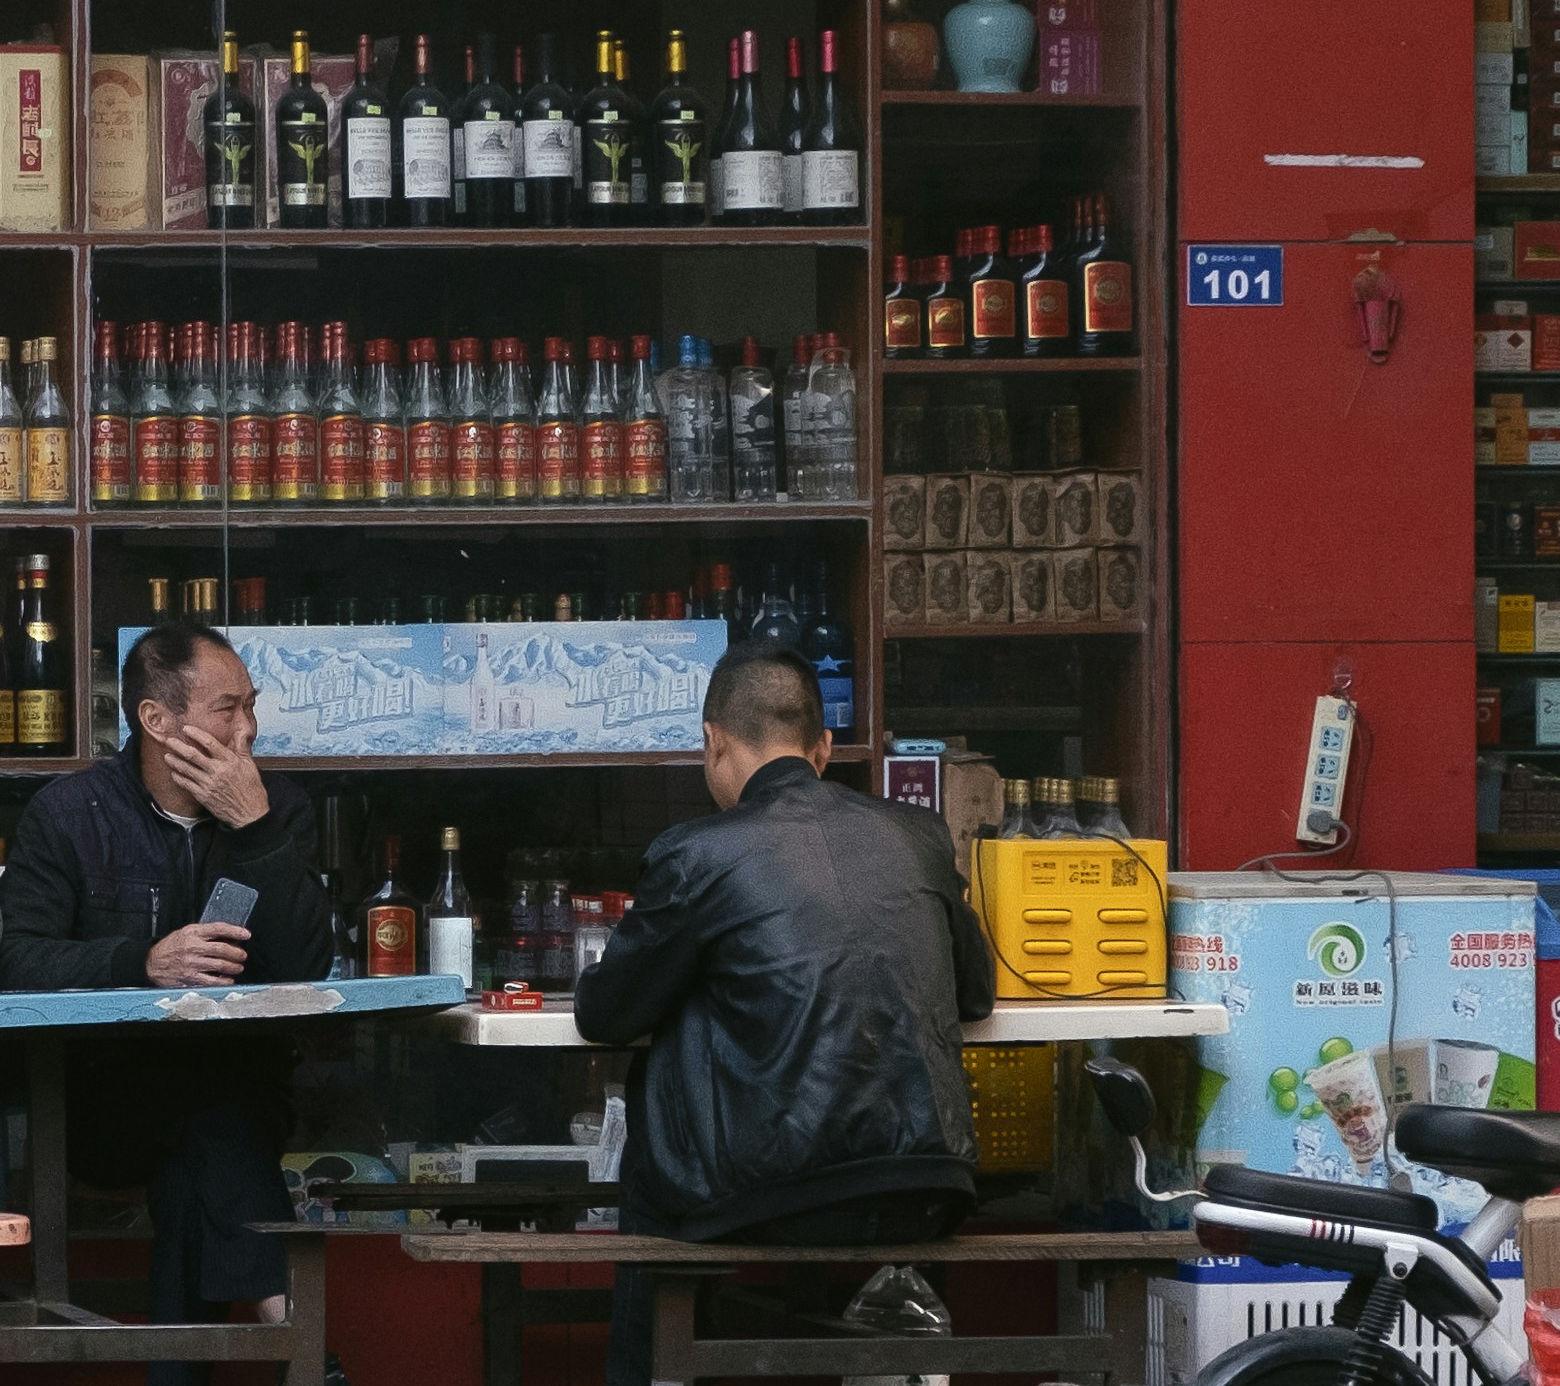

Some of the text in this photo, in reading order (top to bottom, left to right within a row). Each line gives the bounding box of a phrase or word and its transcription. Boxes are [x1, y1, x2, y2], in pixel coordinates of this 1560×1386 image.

[1204, 269, 1270, 299] 101
[1450, 933, 1536, 952] 全国服务热
[1450, 954, 1527, 968] 4008 923
